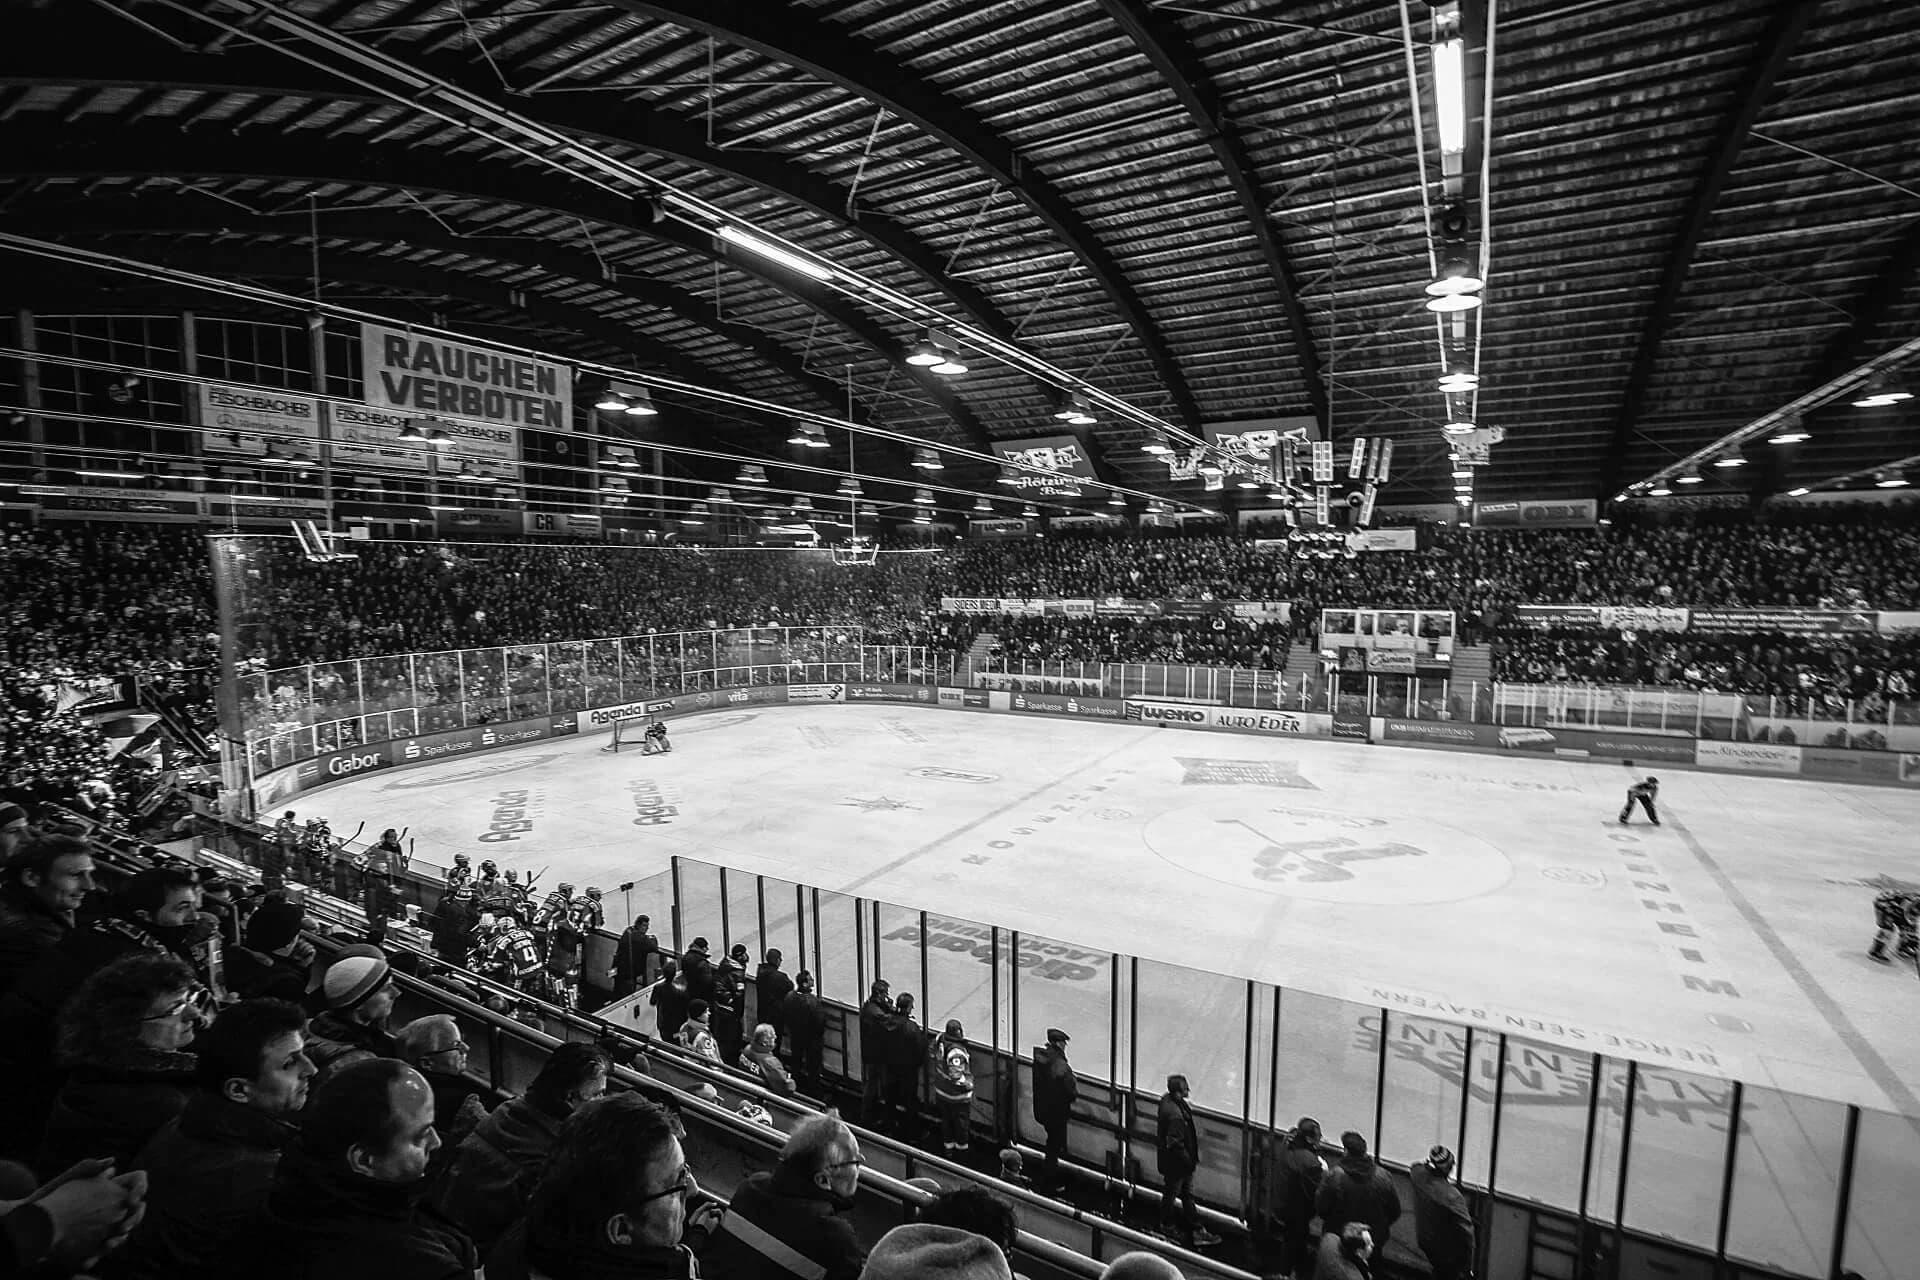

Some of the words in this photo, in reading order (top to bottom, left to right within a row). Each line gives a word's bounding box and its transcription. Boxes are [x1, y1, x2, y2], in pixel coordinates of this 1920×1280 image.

[384, 333, 556, 396] RAUCHEN
[380, 370, 562, 429] VERBOTEN
[591, 705, 641, 724] Agenda
[1216, 715, 1256, 728] AUTO
[499, 728, 542, 743] Sparkasse
[424, 741, 473, 757] Sparkasse
[329, 753, 382, 775] Gabor
[478, 789, 534, 843] Agenda
